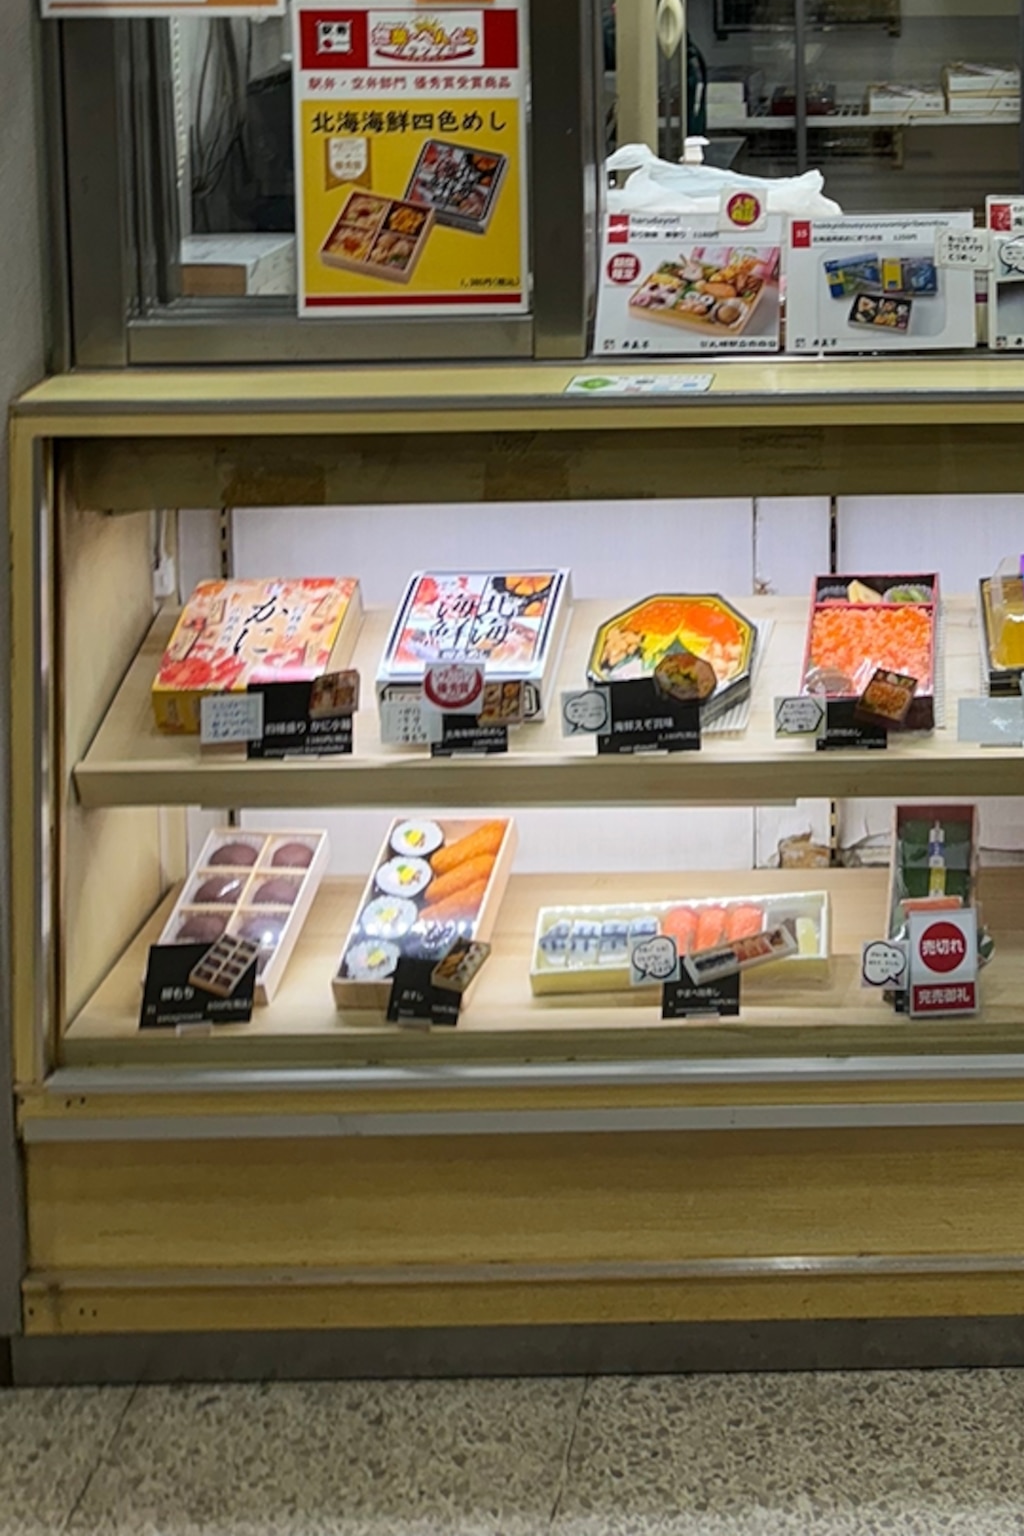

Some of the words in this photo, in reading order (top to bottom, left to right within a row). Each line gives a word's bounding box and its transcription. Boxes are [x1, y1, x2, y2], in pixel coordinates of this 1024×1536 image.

[310, 109, 508, 134] 北海海鮮四色めし
[921, 939, 964, 957] 売切れ
[918, 988, 970, 1005] 完売御礼
